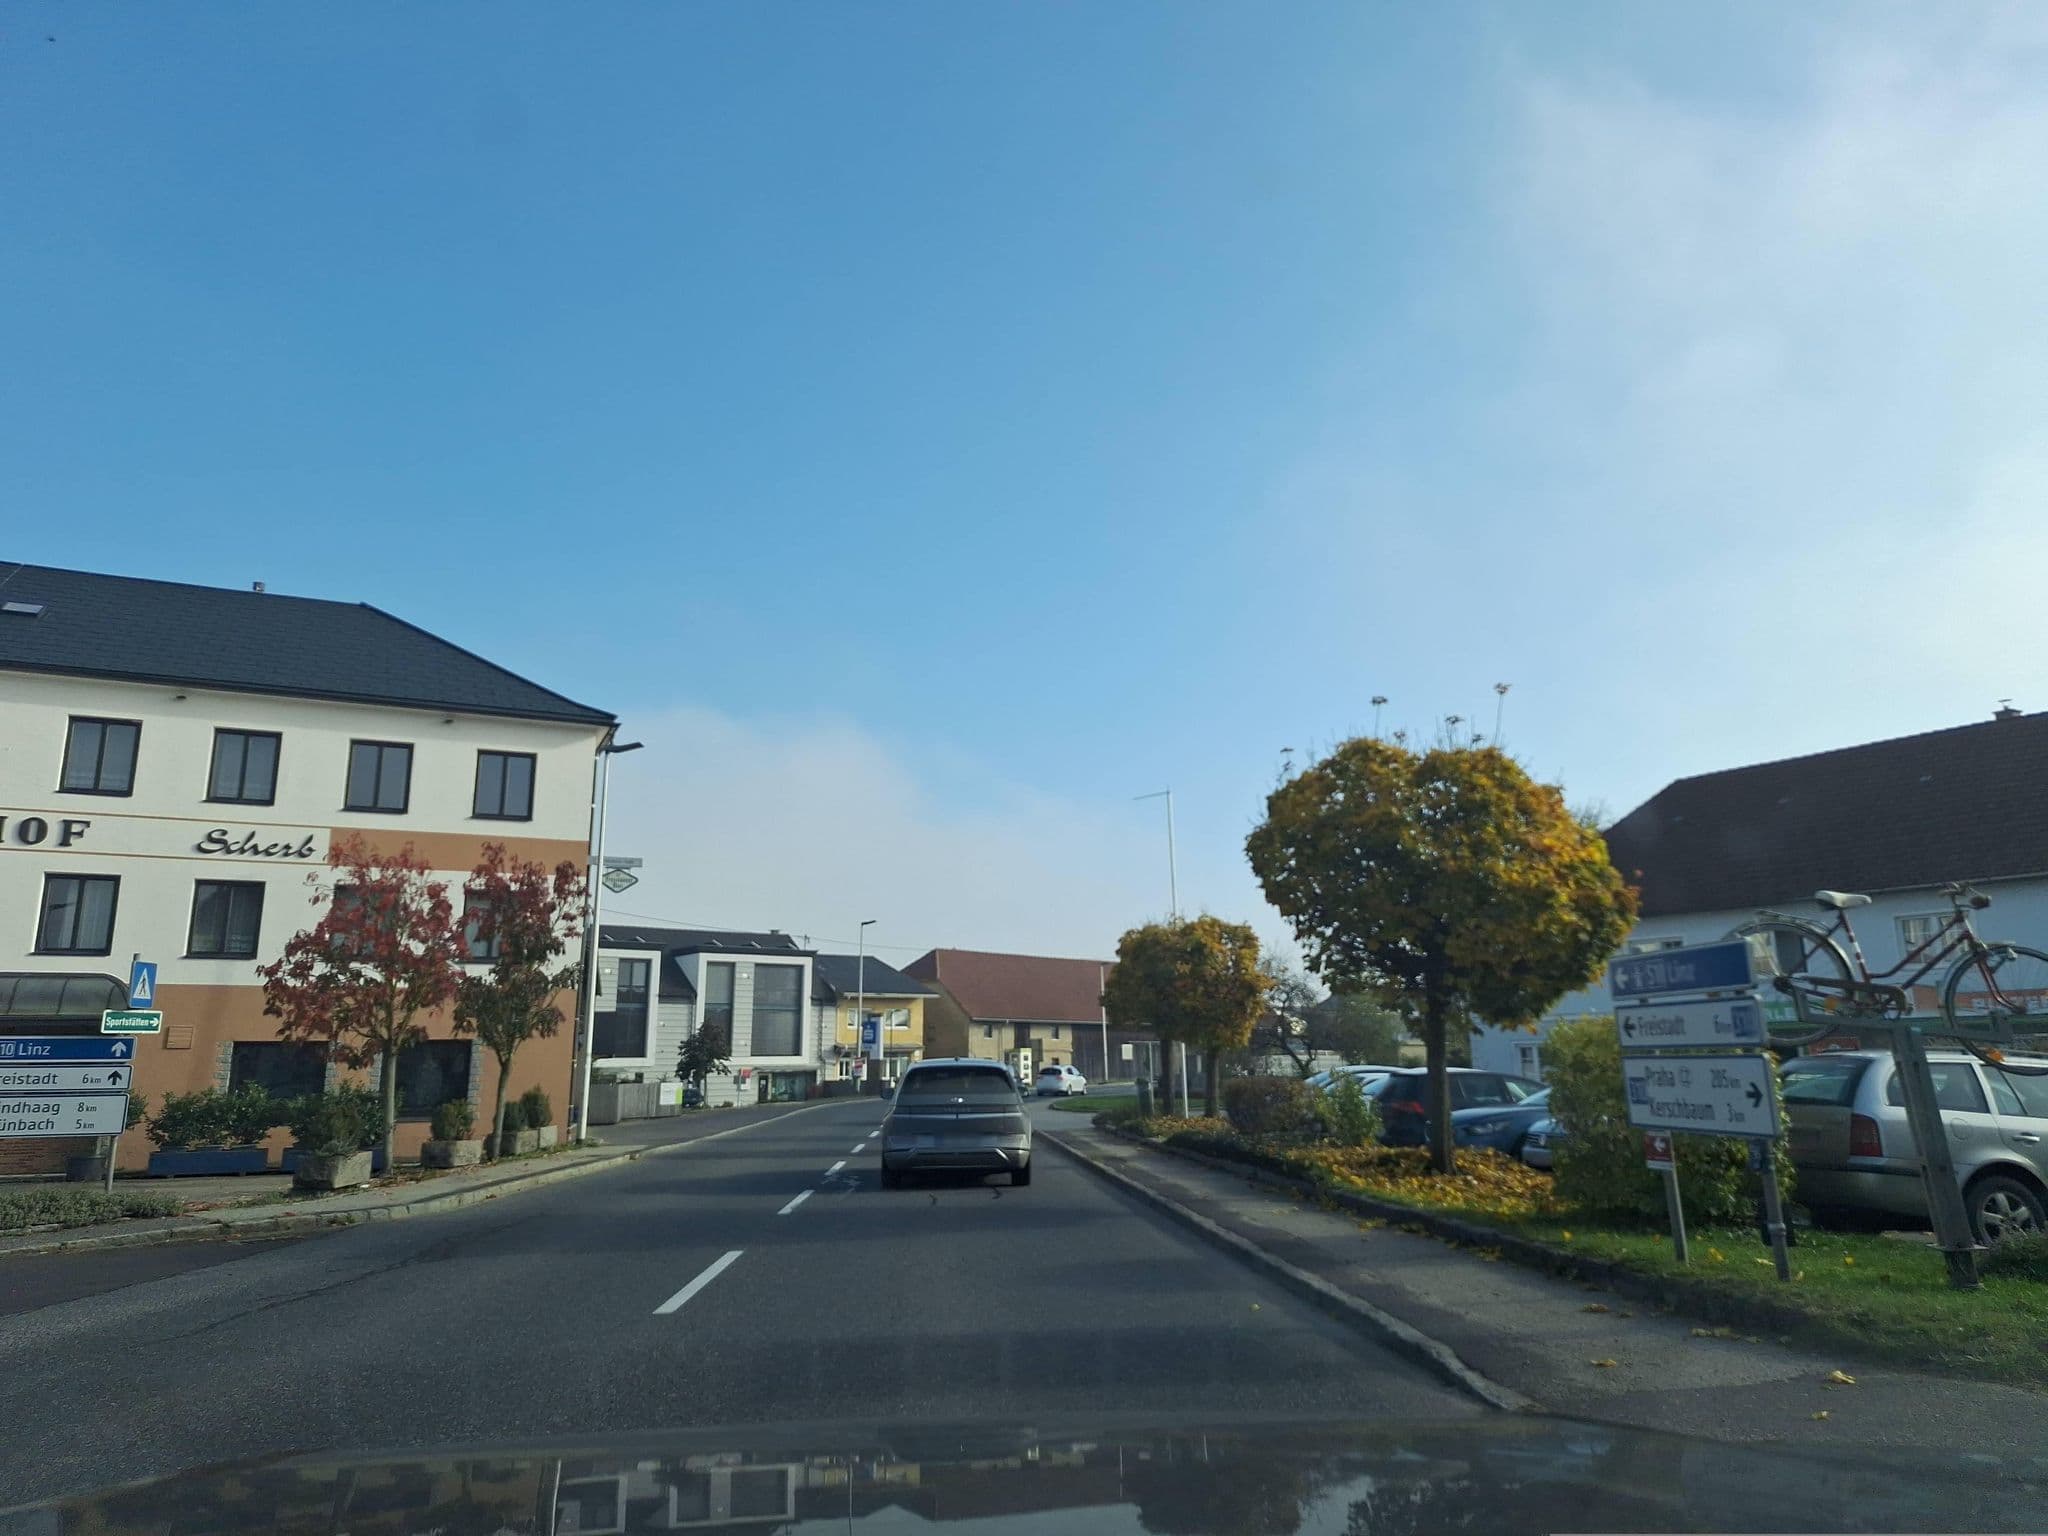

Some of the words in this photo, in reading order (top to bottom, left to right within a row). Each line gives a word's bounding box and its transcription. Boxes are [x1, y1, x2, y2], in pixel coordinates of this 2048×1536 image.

[197, 828, 315, 858] Scherb
[106, 1016, 149, 1028] Sportstätten
[19, 1042, 51, 1056] Linz
[82, 1073, 89, 1084] 6
[77, 1102, 85, 1113] 8
[75, 1119, 82, 1130] 5
